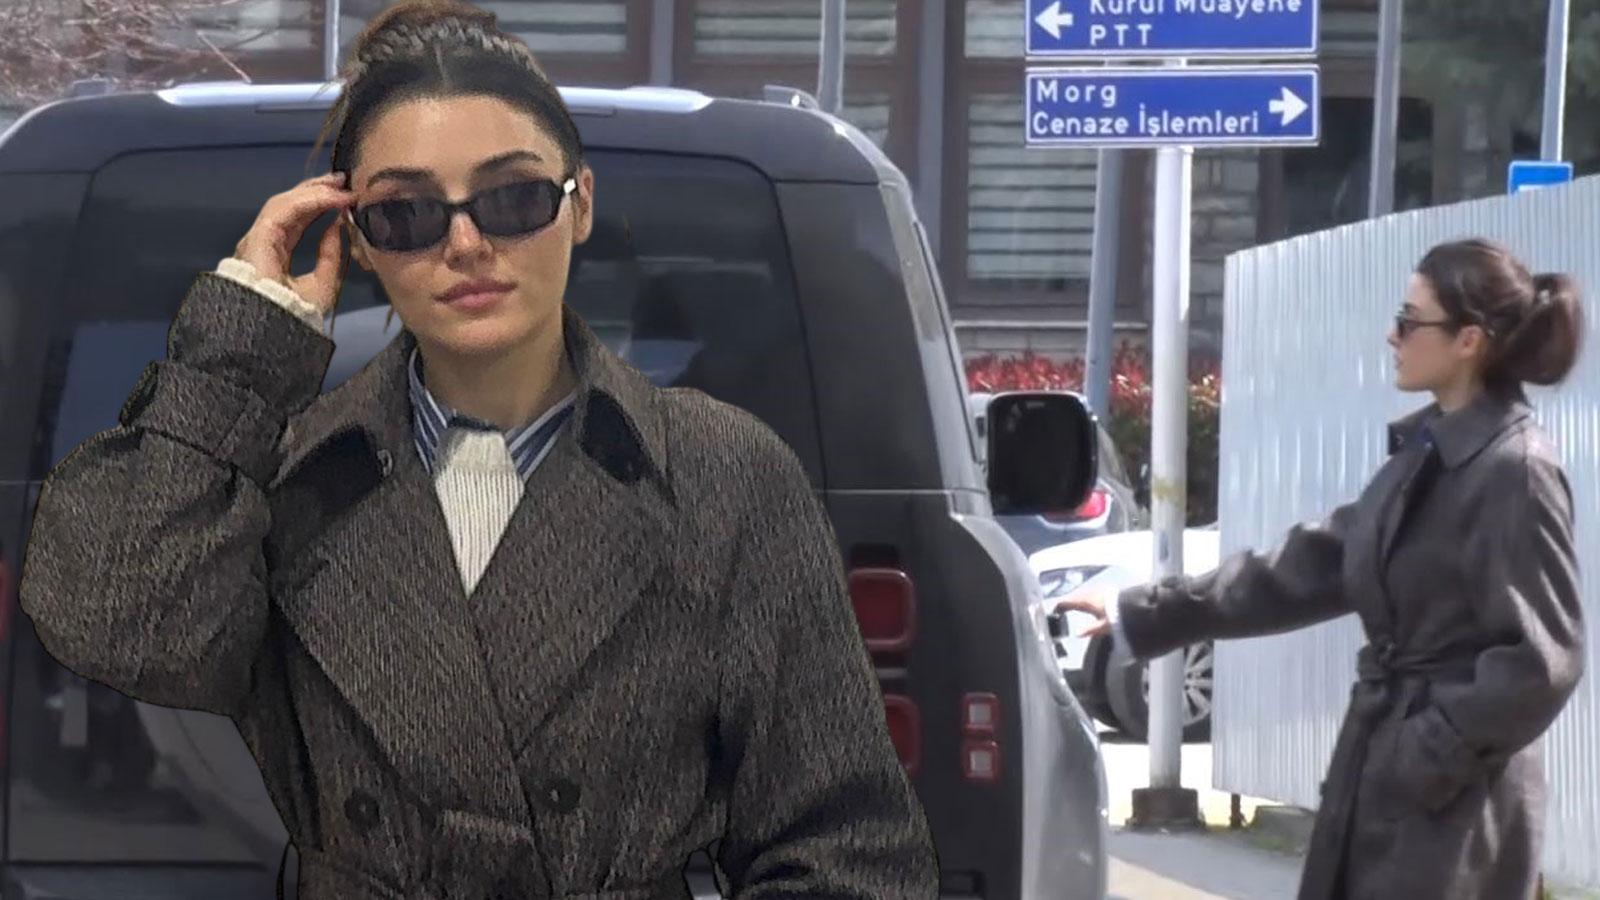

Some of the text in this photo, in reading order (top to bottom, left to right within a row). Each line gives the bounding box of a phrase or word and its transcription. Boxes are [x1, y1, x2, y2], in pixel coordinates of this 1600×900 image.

[1175, 0, 1301, 19] Muayene
[1036, 80, 1117, 108] Morg
[1033, 103, 1259, 136] Cenaze İşlemleri
